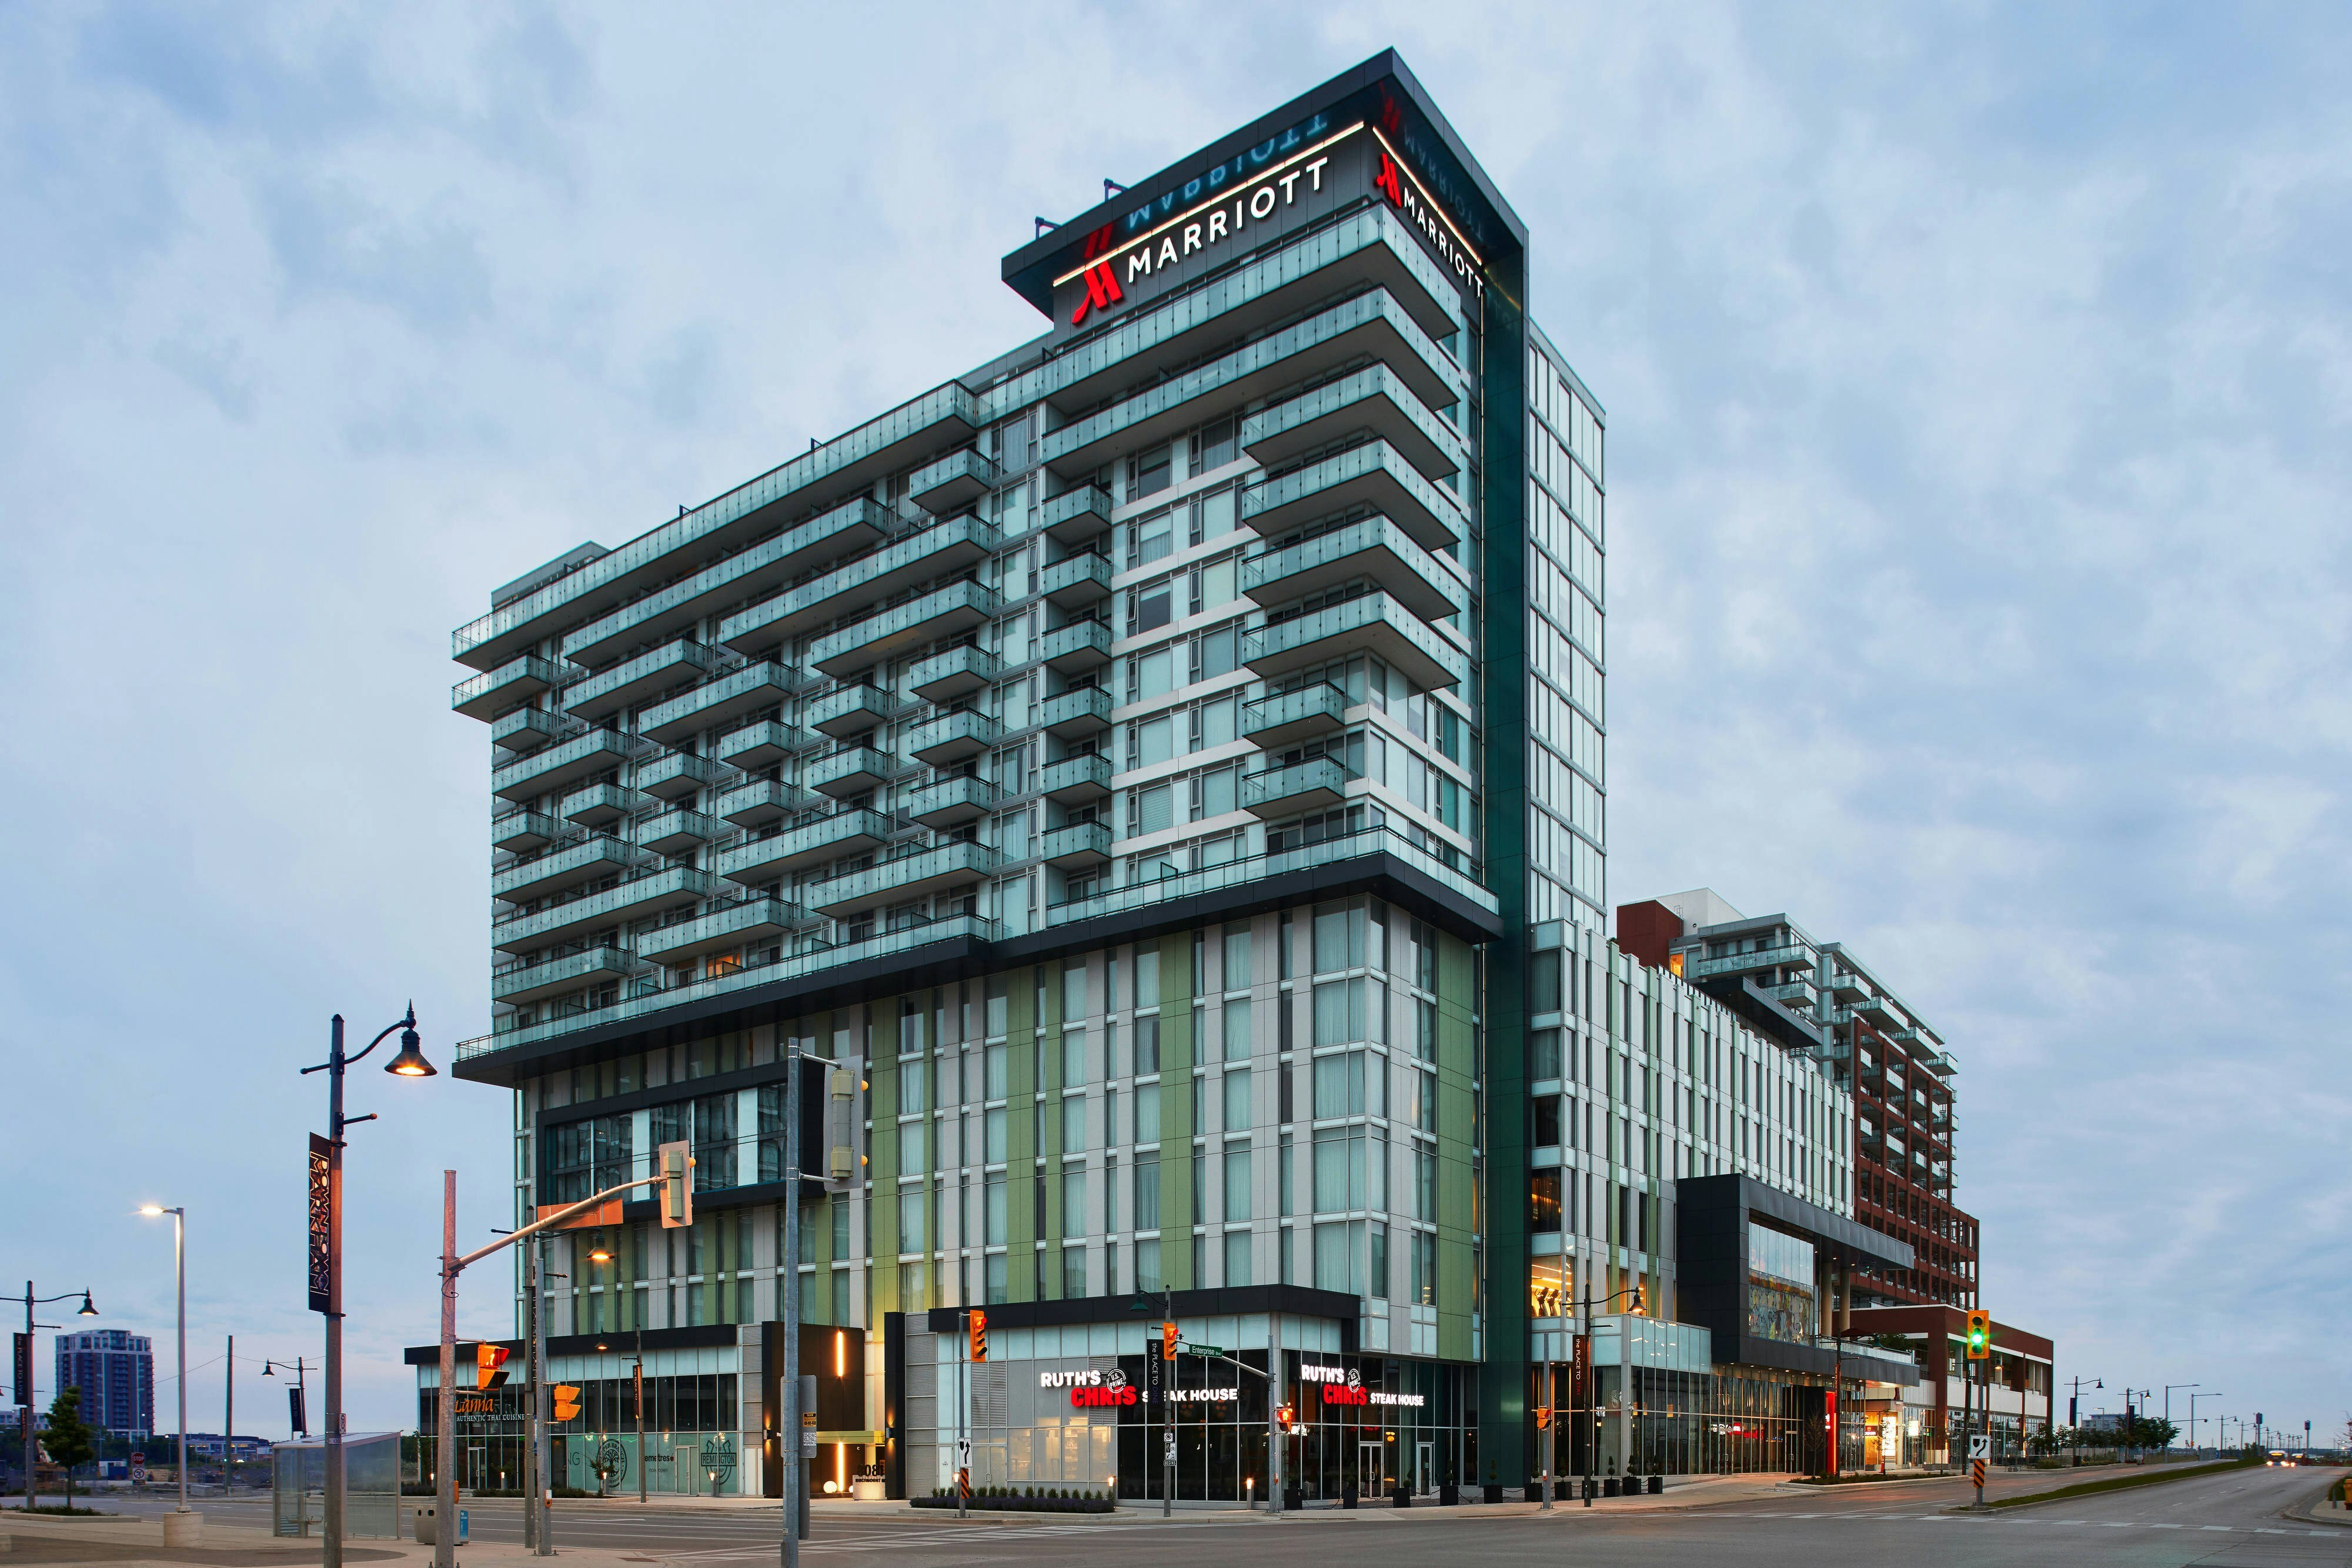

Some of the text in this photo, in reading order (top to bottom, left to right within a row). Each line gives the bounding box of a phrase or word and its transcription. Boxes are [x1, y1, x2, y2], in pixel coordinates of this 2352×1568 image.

[1128, 156, 1328, 283] MARRIOTT
[1404, 186, 1483, 297] MARRIOTT
[1192, 1346, 1215, 1356] Enterprise
[1041, 1370, 1101, 1388] RUTH'S
[1111, 1373, 1120, 1381] U.S.
[1152, 1375, 1158, 1385] TO
[1301, 1365, 1345, 1383] RUTH'S
[1576, 1371, 1581, 1380] TO
[1110, 1378, 1124, 1389] PRIME
[1071, 1386, 1137, 1407] CHRIS
[1142, 1389, 1238, 1403] SAK HOUSE
[1324, 1384, 1367, 1406] CHRIS
[1370, 1392, 1424, 1406] STEAK HOUSE
[644, 1453, 670, 1462] emetres
